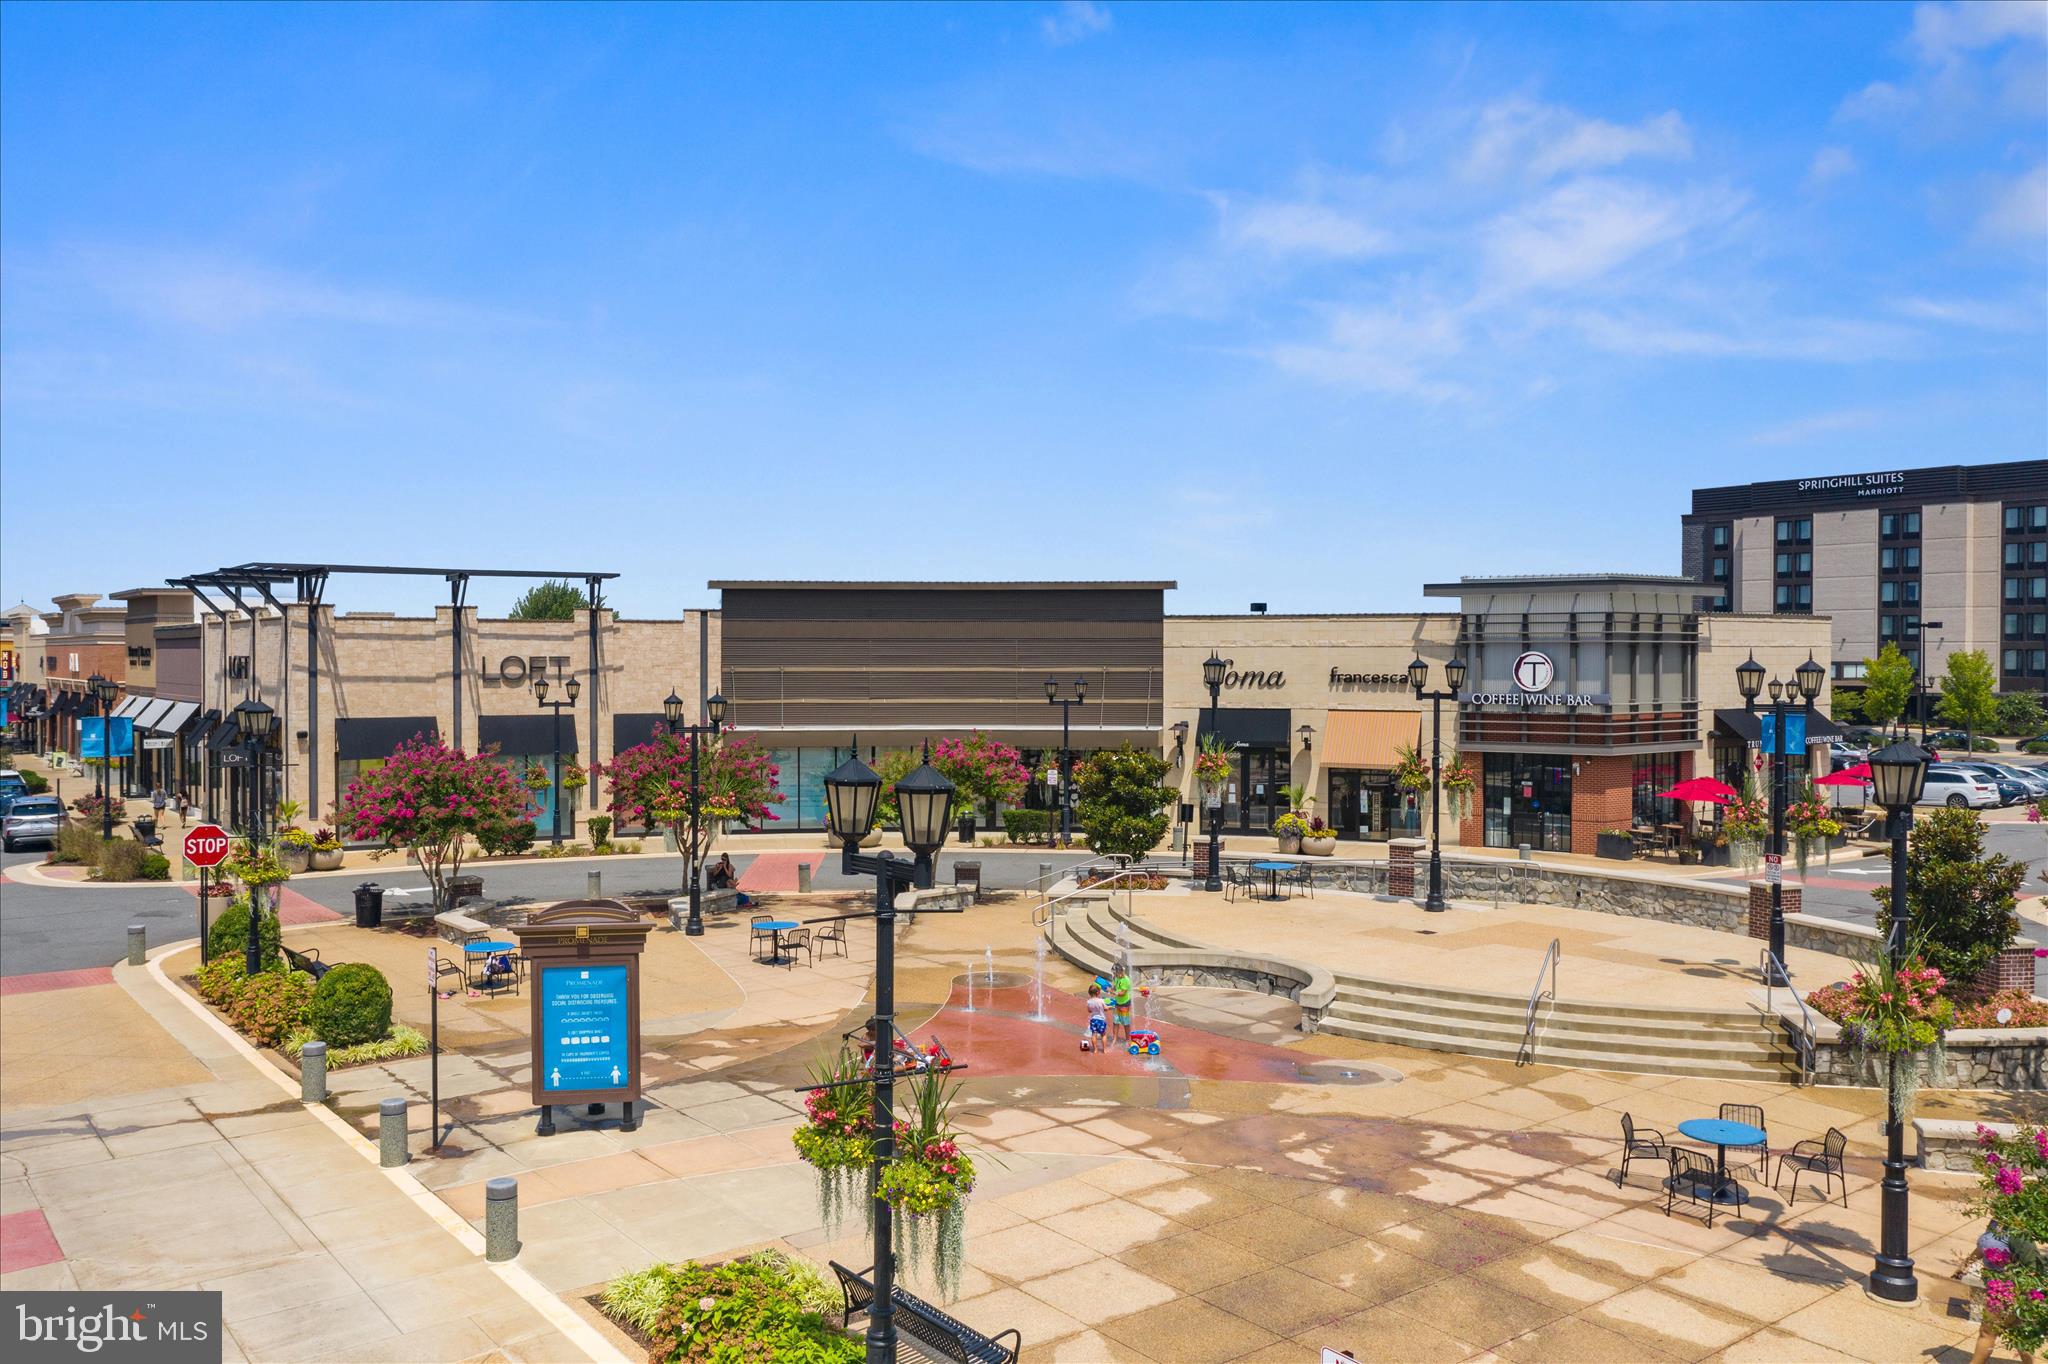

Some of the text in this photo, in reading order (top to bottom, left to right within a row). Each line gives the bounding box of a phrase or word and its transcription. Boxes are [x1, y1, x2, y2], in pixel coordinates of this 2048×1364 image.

[1798, 472, 1904, 491] SPRINGHILL SUITES
[1857, 486, 1904, 496] MARRIOTT
[229, 656, 250, 679] LOFT
[482, 655, 571, 681] LOFT
[1566, 694, 1593, 706] BAR
[223, 754, 248, 762] LOF
[187, 838, 226, 855] STOP
[1768, 855, 1779, 863] NO
